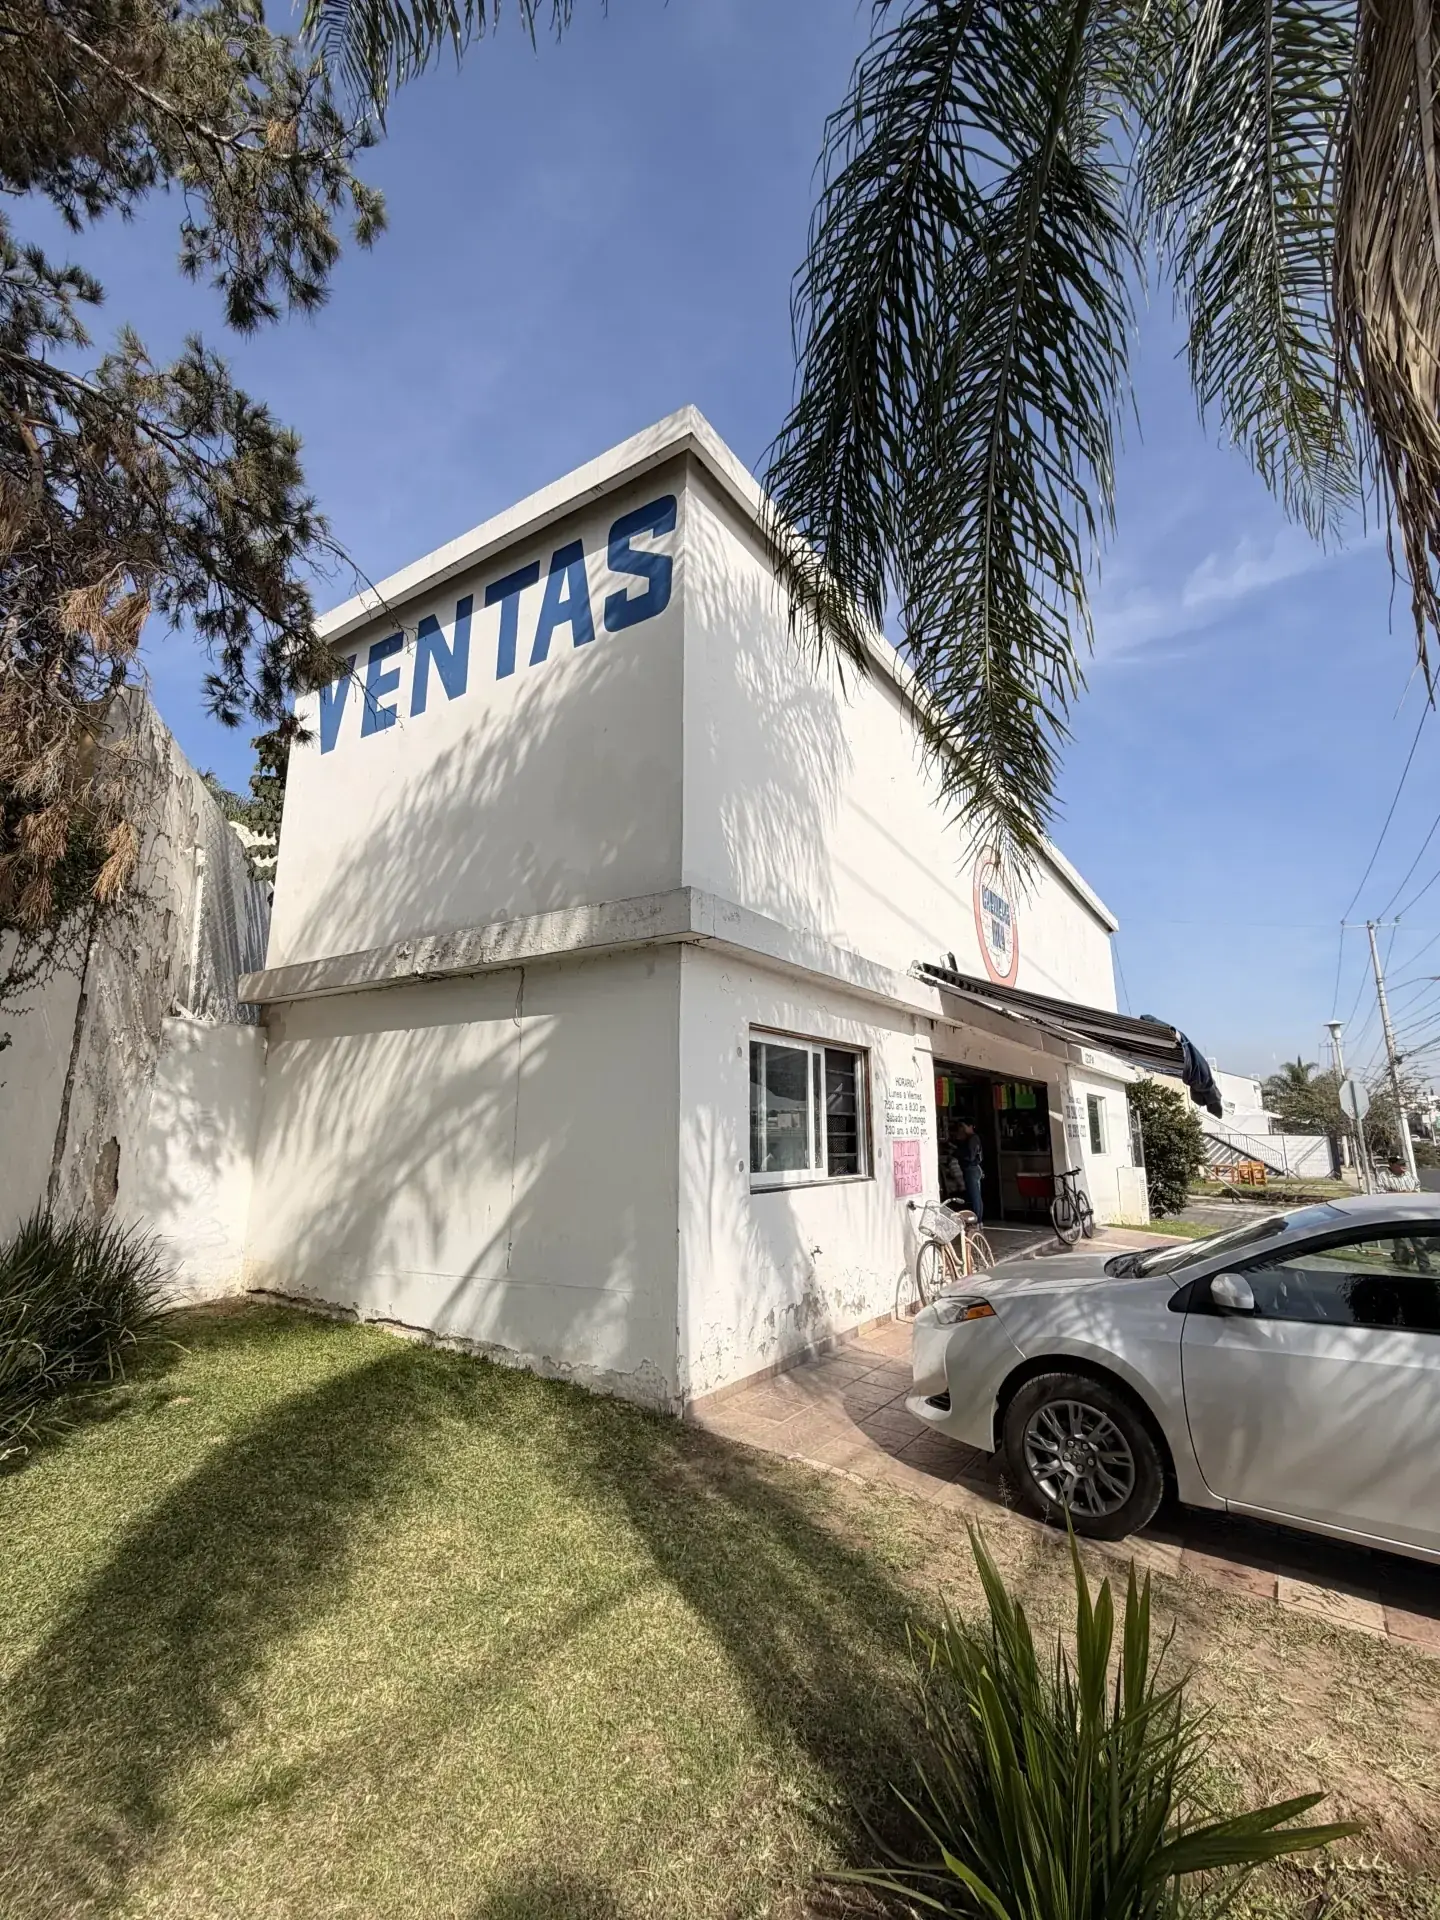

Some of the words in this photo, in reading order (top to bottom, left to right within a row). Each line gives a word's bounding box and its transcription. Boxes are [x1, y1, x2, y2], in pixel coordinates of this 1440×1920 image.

[318, 494, 678, 756] VENTAS
[888, 1088, 902, 1099] Lunes
[907, 1090, 922, 1101] Viernes
[908, 1114, 926, 1126] Domingo
